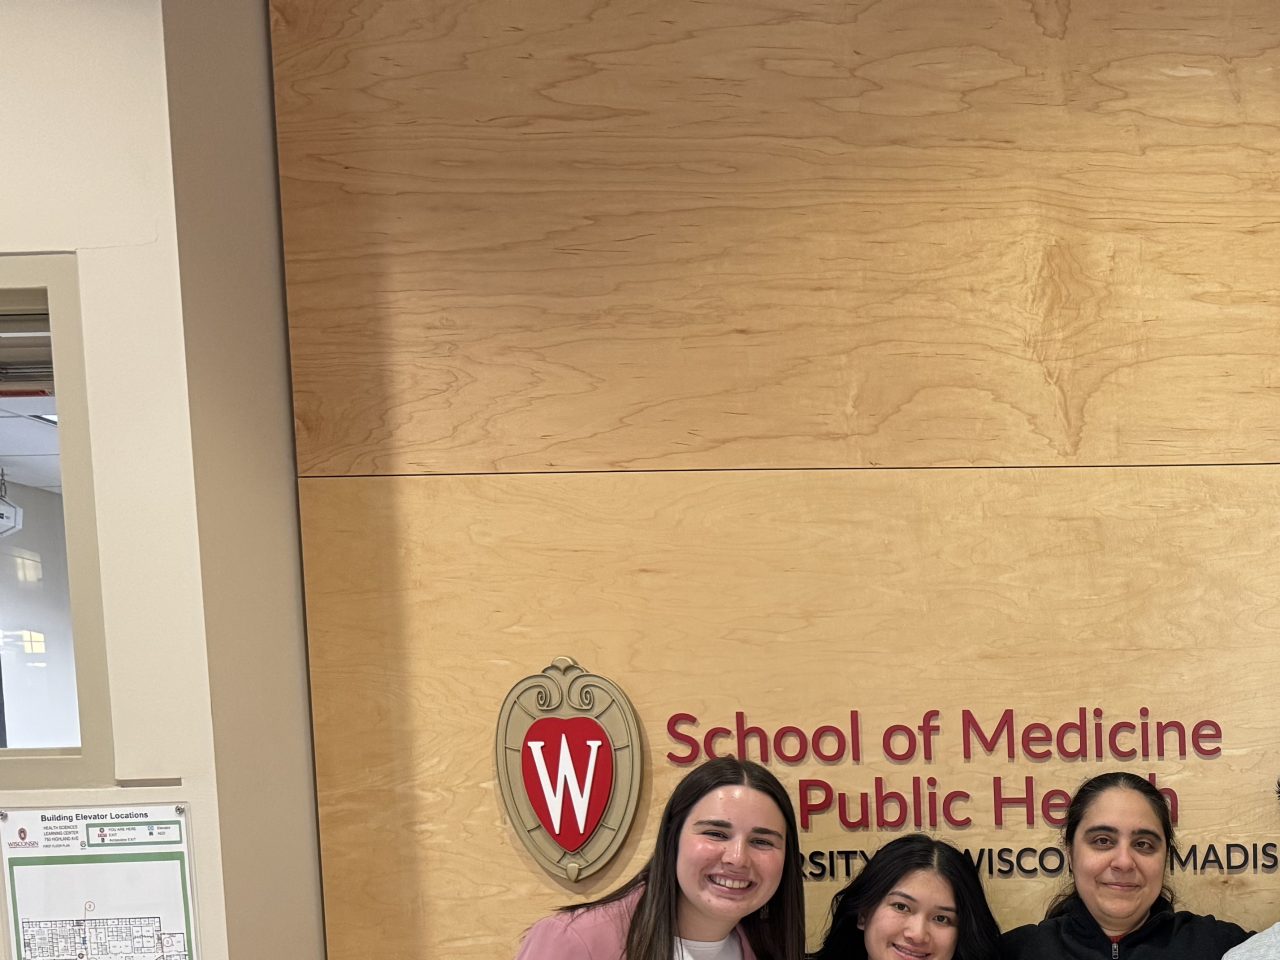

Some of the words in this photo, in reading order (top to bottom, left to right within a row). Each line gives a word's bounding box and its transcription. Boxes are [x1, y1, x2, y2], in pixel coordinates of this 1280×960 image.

[666, 711, 860, 765] School
[883, 710, 940, 761] of
[962, 707, 1222, 761] Medicine
[527, 733, 602, 834] W
[799, 777, 971, 831] Public
[993, 772, 1178, 827] Heh
[41, 814, 73, 822] Building
[75, 813, 107, 821] Elevator
[110, 811, 148, 819] Locations
[963, 847, 1071, 874] WISCO
